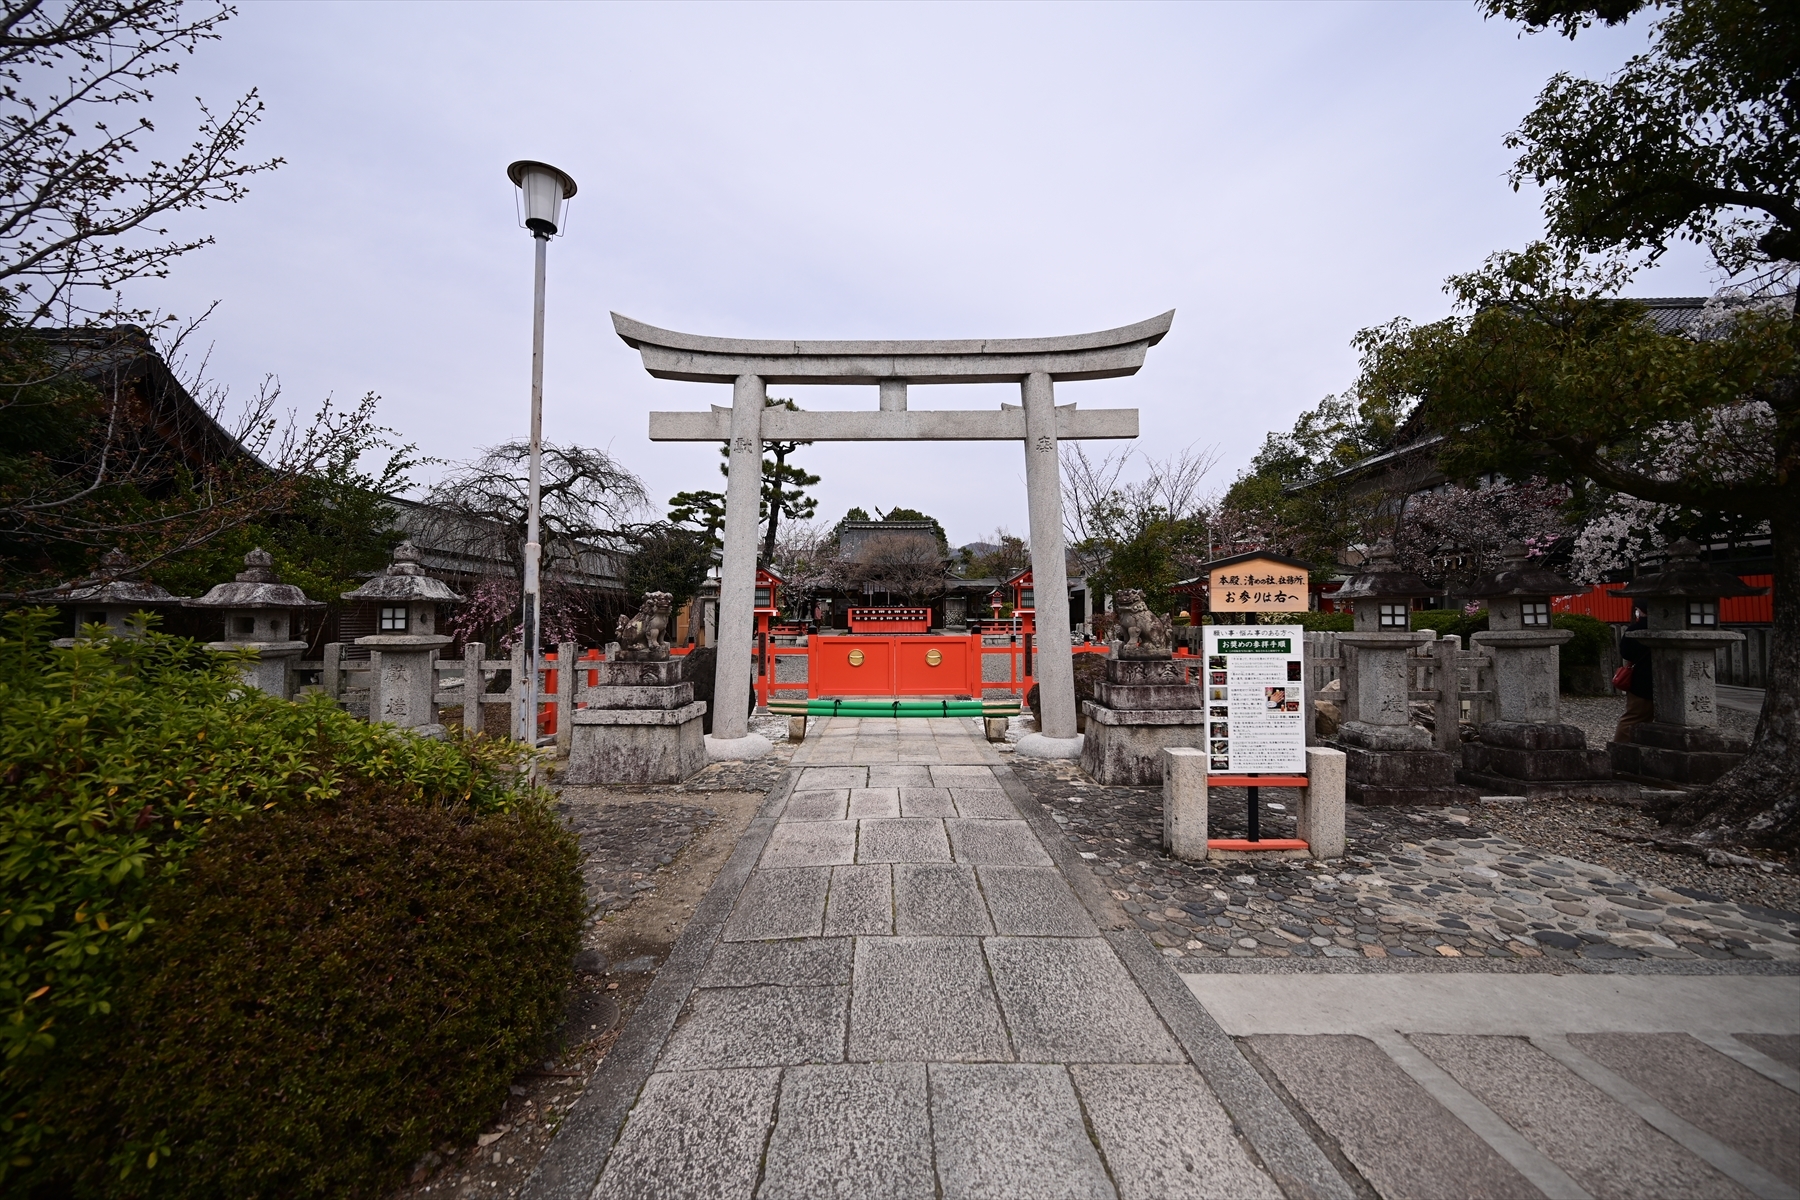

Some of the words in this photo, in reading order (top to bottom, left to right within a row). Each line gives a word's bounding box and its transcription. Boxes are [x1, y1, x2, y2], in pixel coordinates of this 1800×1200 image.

[1225, 590, 1299, 604] お参りは右へ
